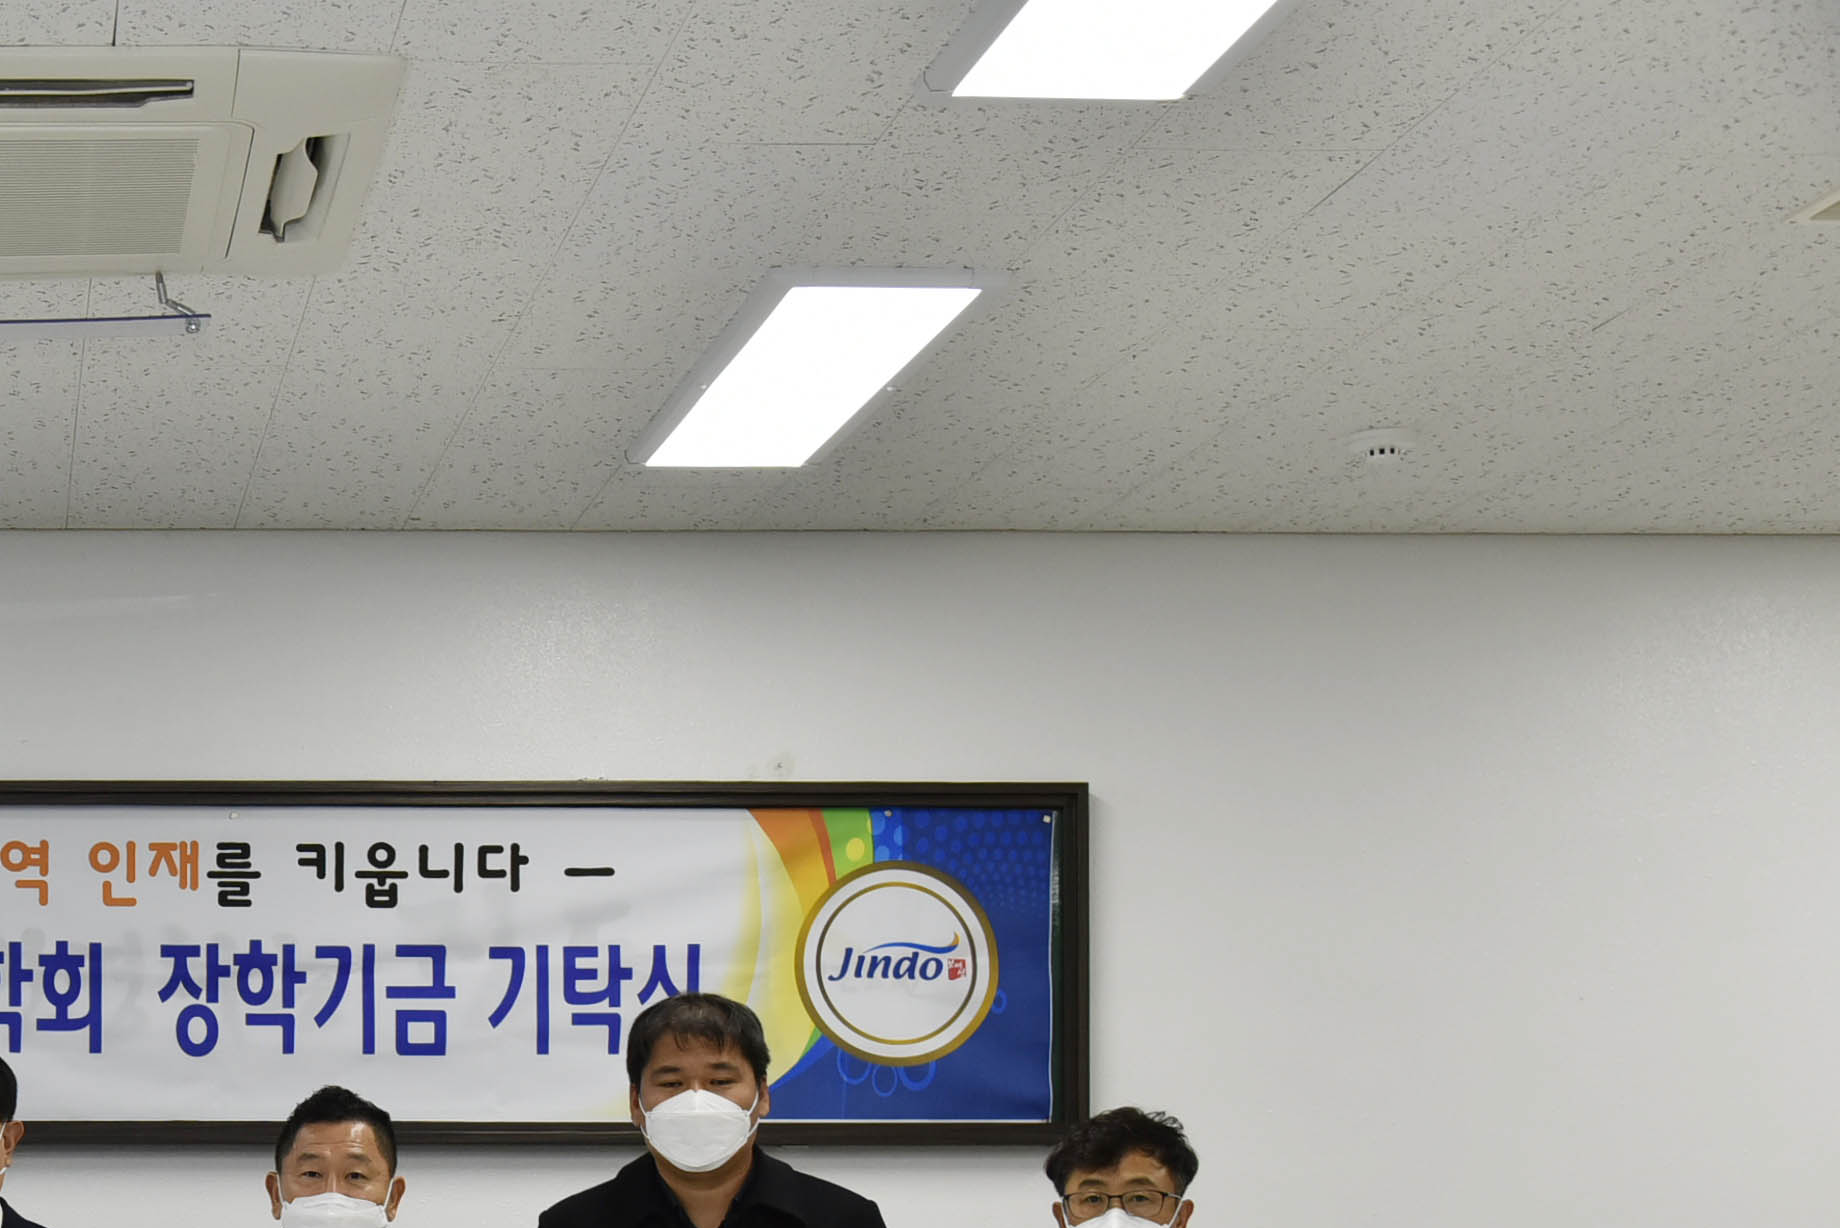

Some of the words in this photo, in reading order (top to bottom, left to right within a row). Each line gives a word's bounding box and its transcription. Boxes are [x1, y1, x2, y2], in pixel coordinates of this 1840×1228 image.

[88, 838, 262, 909] 인재를
[295, 840, 531, 909] 키웁니다
[159, 940, 457, 1058] 장학기금
[828, 947, 944, 982] Jindo
